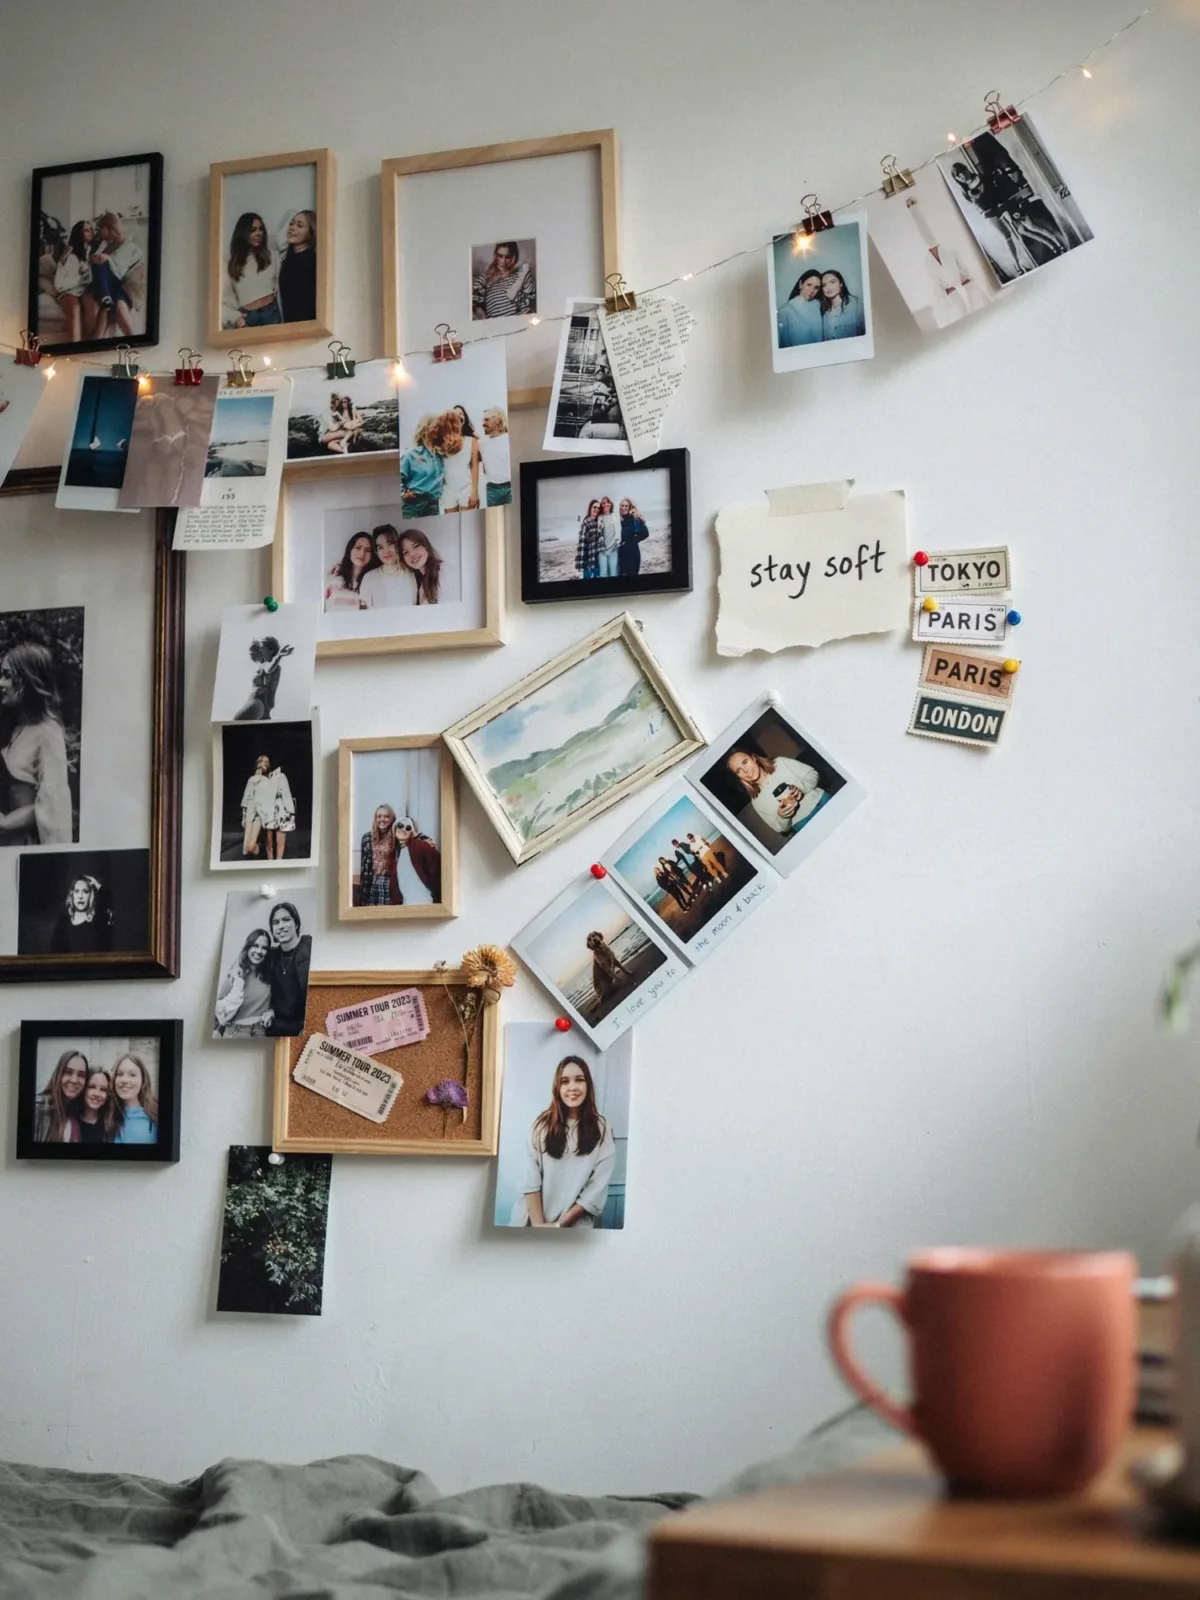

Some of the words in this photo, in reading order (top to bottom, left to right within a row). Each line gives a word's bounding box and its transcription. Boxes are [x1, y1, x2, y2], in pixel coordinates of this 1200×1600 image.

[750, 555, 811, 600] stay
[824, 539, 886, 581] soft
[927, 560, 1001, 582] TOKYO
[928, 611, 997, 632] PARIS
[934, 658, 1003, 688] PARIS
[920, 703, 999, 735] LONDON
[695, 937, 710, 952] the
[711, 915, 732, 936] moon
[742, 883, 766, 905] back
[335, 1007, 369, 1024] SUMMER
[369, 1000, 390, 1015] TOUR
[391, 994, 411, 1008] 2023
[611, 1017, 622, 1030] I
[626, 997, 645, 1015] love
[648, 981, 664, 999] you
[666, 968, 676, 979] to
[319, 1041, 352, 1063] SUMMER
[351, 1056, 371, 1074] TOUR
[370, 1067, 392, 1085] 2023
